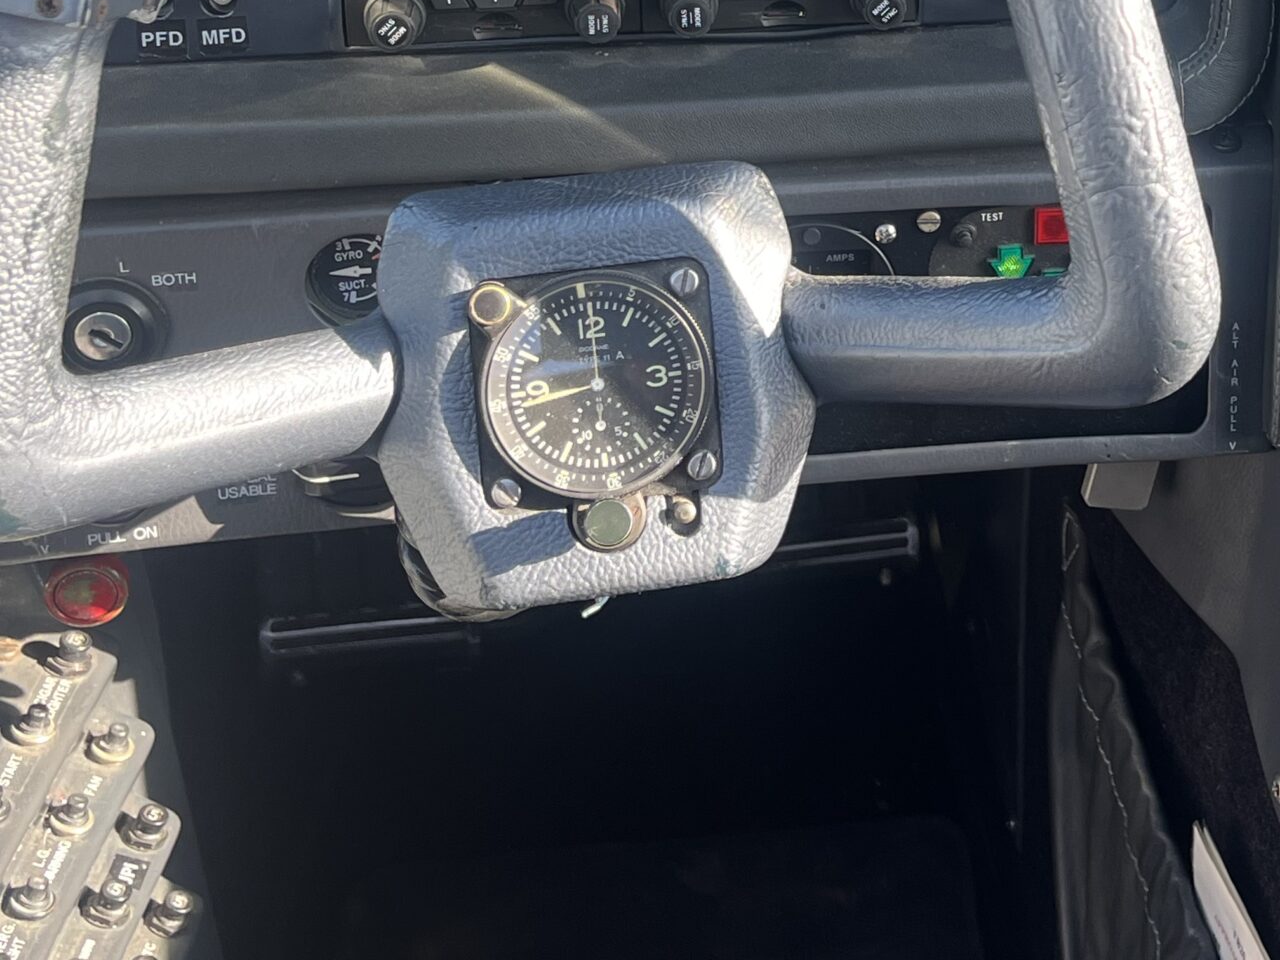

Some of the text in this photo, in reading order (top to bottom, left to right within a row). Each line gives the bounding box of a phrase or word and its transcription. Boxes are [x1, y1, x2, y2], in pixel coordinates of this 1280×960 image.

[872, 0, 889, 16] MODE
[882, 8, 898, 23] SYNC
[141, 31, 184, 48] PFD
[202, 28, 246, 45] MFD
[981, 212, 1003, 222] TEST
[334, 250, 363, 262] GYRO
[826, 254, 855, 262] AMPS
[119, 262, 129, 273] L
[151, 272, 197, 287] BOTH
[578, 316, 606, 340] 12
[645, 365, 668, 387] 3
[525, 380, 550, 401] 9
[218, 483, 276, 500] USABLE
[88, 526, 158, 545] PULL ON
[85, 775, 103, 796] FAN
[118, 862, 139, 885] JPI
